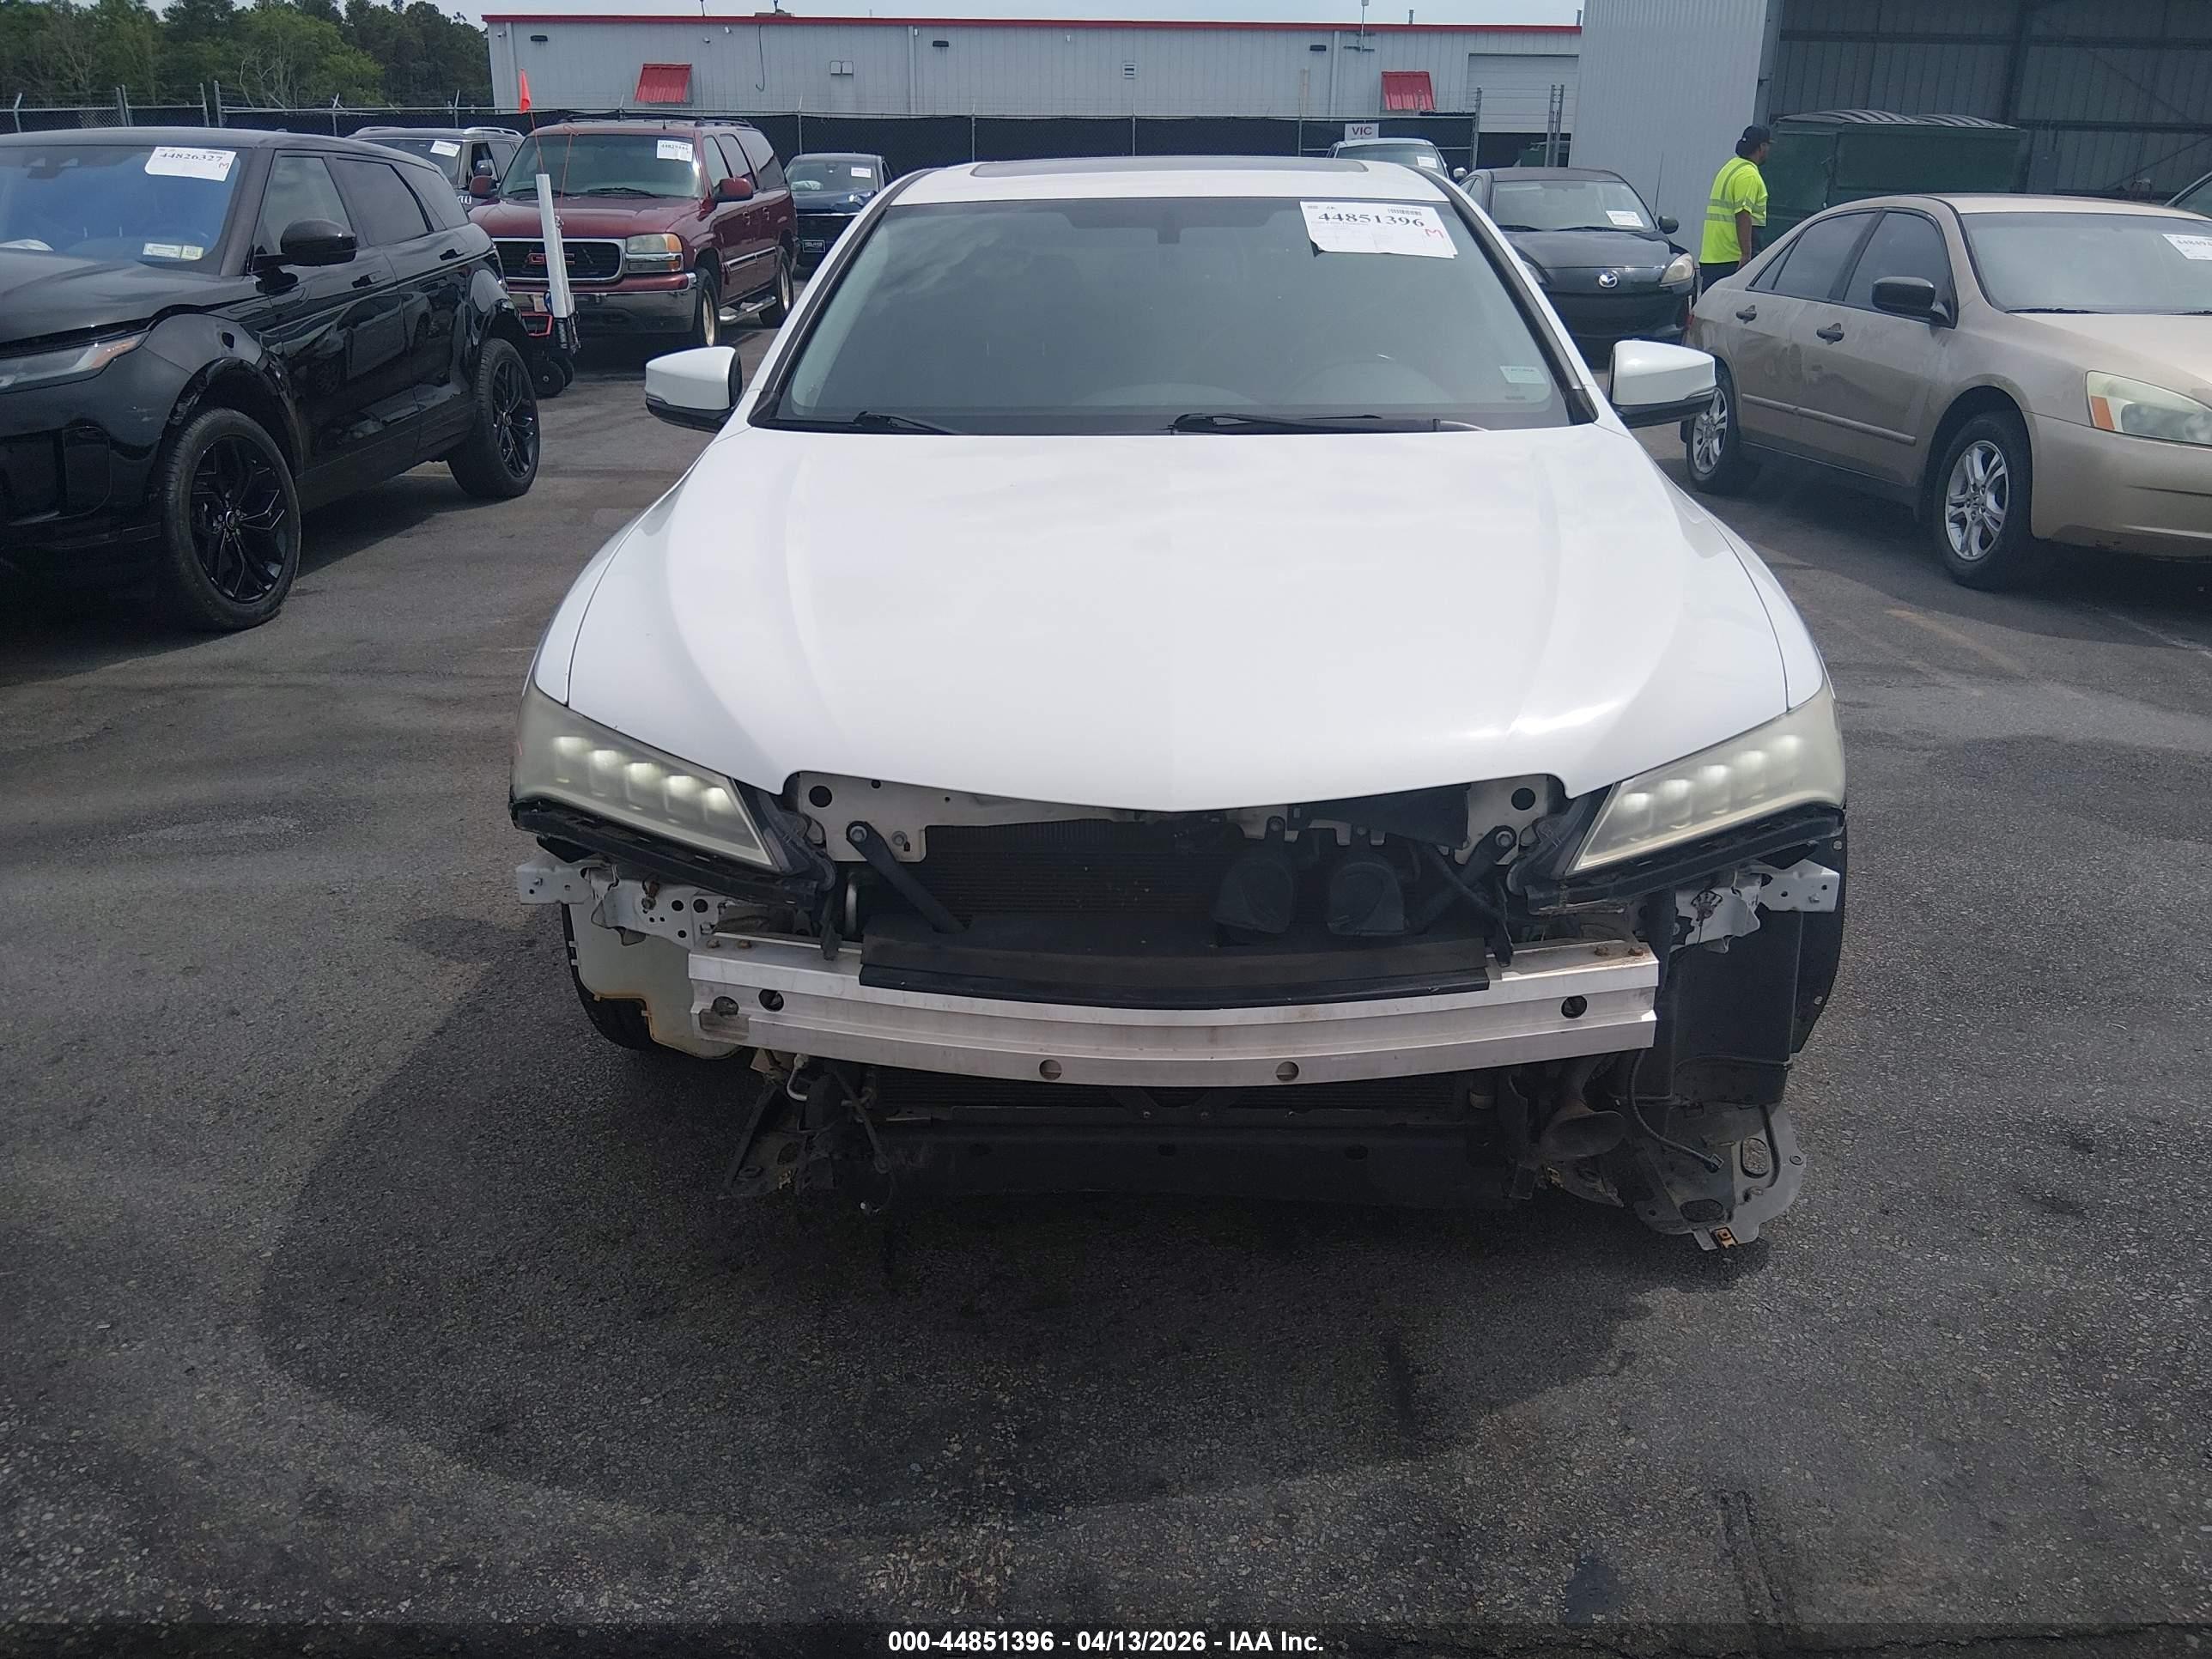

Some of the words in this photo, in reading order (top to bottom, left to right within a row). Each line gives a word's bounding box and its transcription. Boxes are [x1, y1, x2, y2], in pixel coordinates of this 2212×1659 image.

[1352, 126, 1373, 136] VIC
[159, 152, 223, 162] 44826327
[1318, 212, 1425, 228] 44851396
[1425, 228, 1445, 239] M
[528, 252, 576, 265] GC
